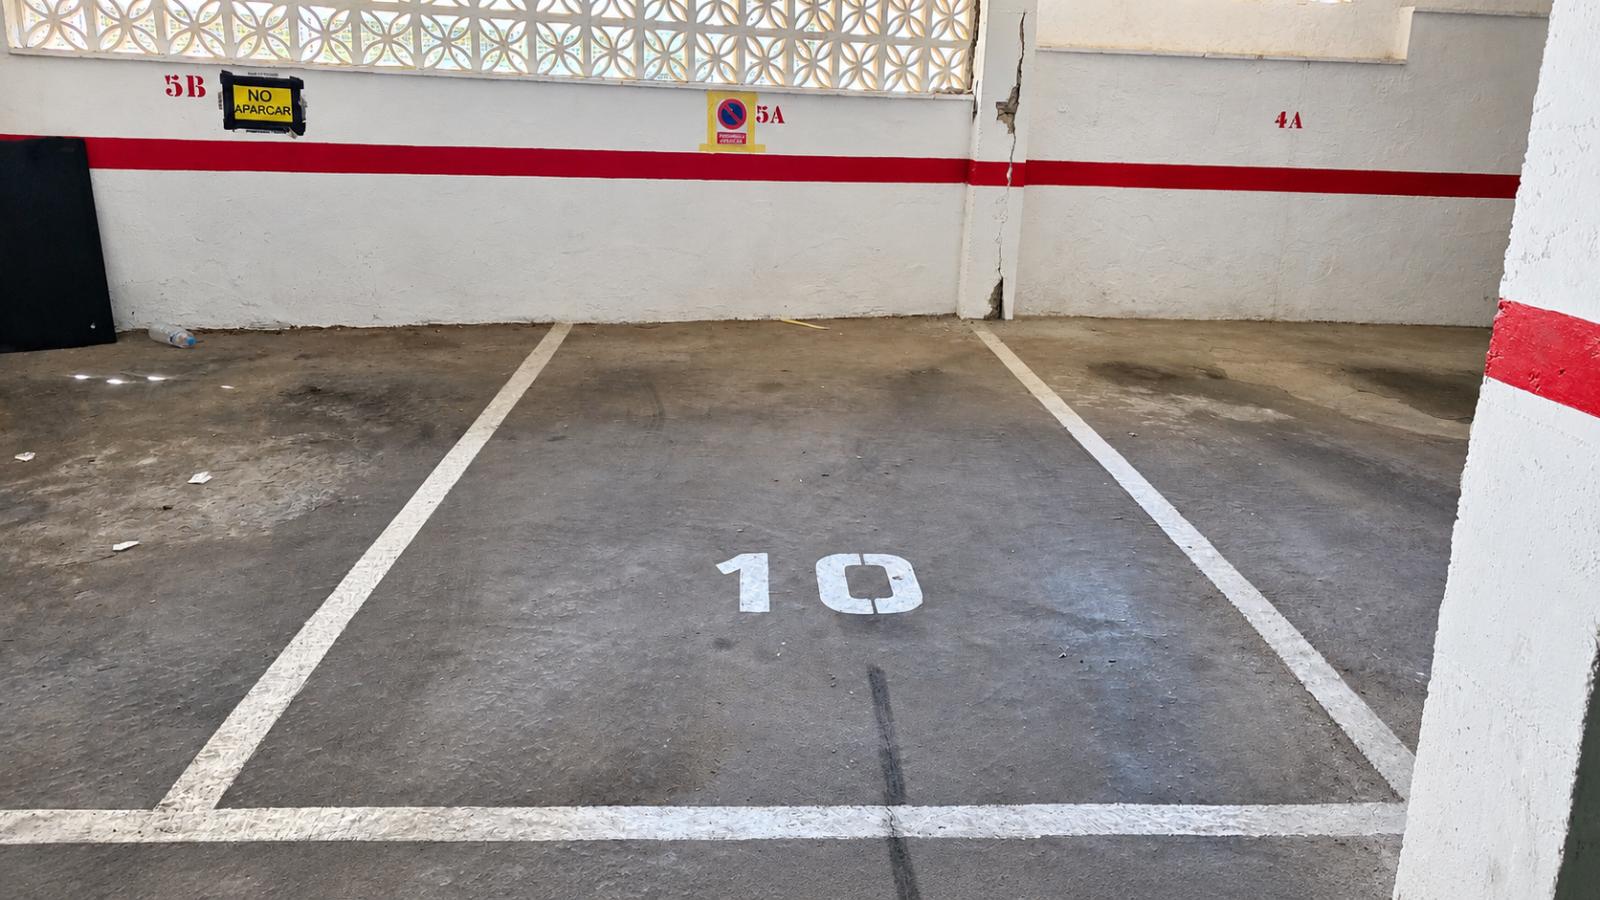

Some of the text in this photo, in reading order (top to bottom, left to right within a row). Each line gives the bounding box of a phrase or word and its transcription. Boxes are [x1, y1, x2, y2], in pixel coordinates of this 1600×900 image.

[164, 73, 206, 98] 5B
[248, 89, 272, 102] NO
[234, 104, 291, 116] APARCAR
[756, 105, 785, 124] 5A
[1274, 111, 1303, 129] 4A
[715, 552, 924, 615] 10
